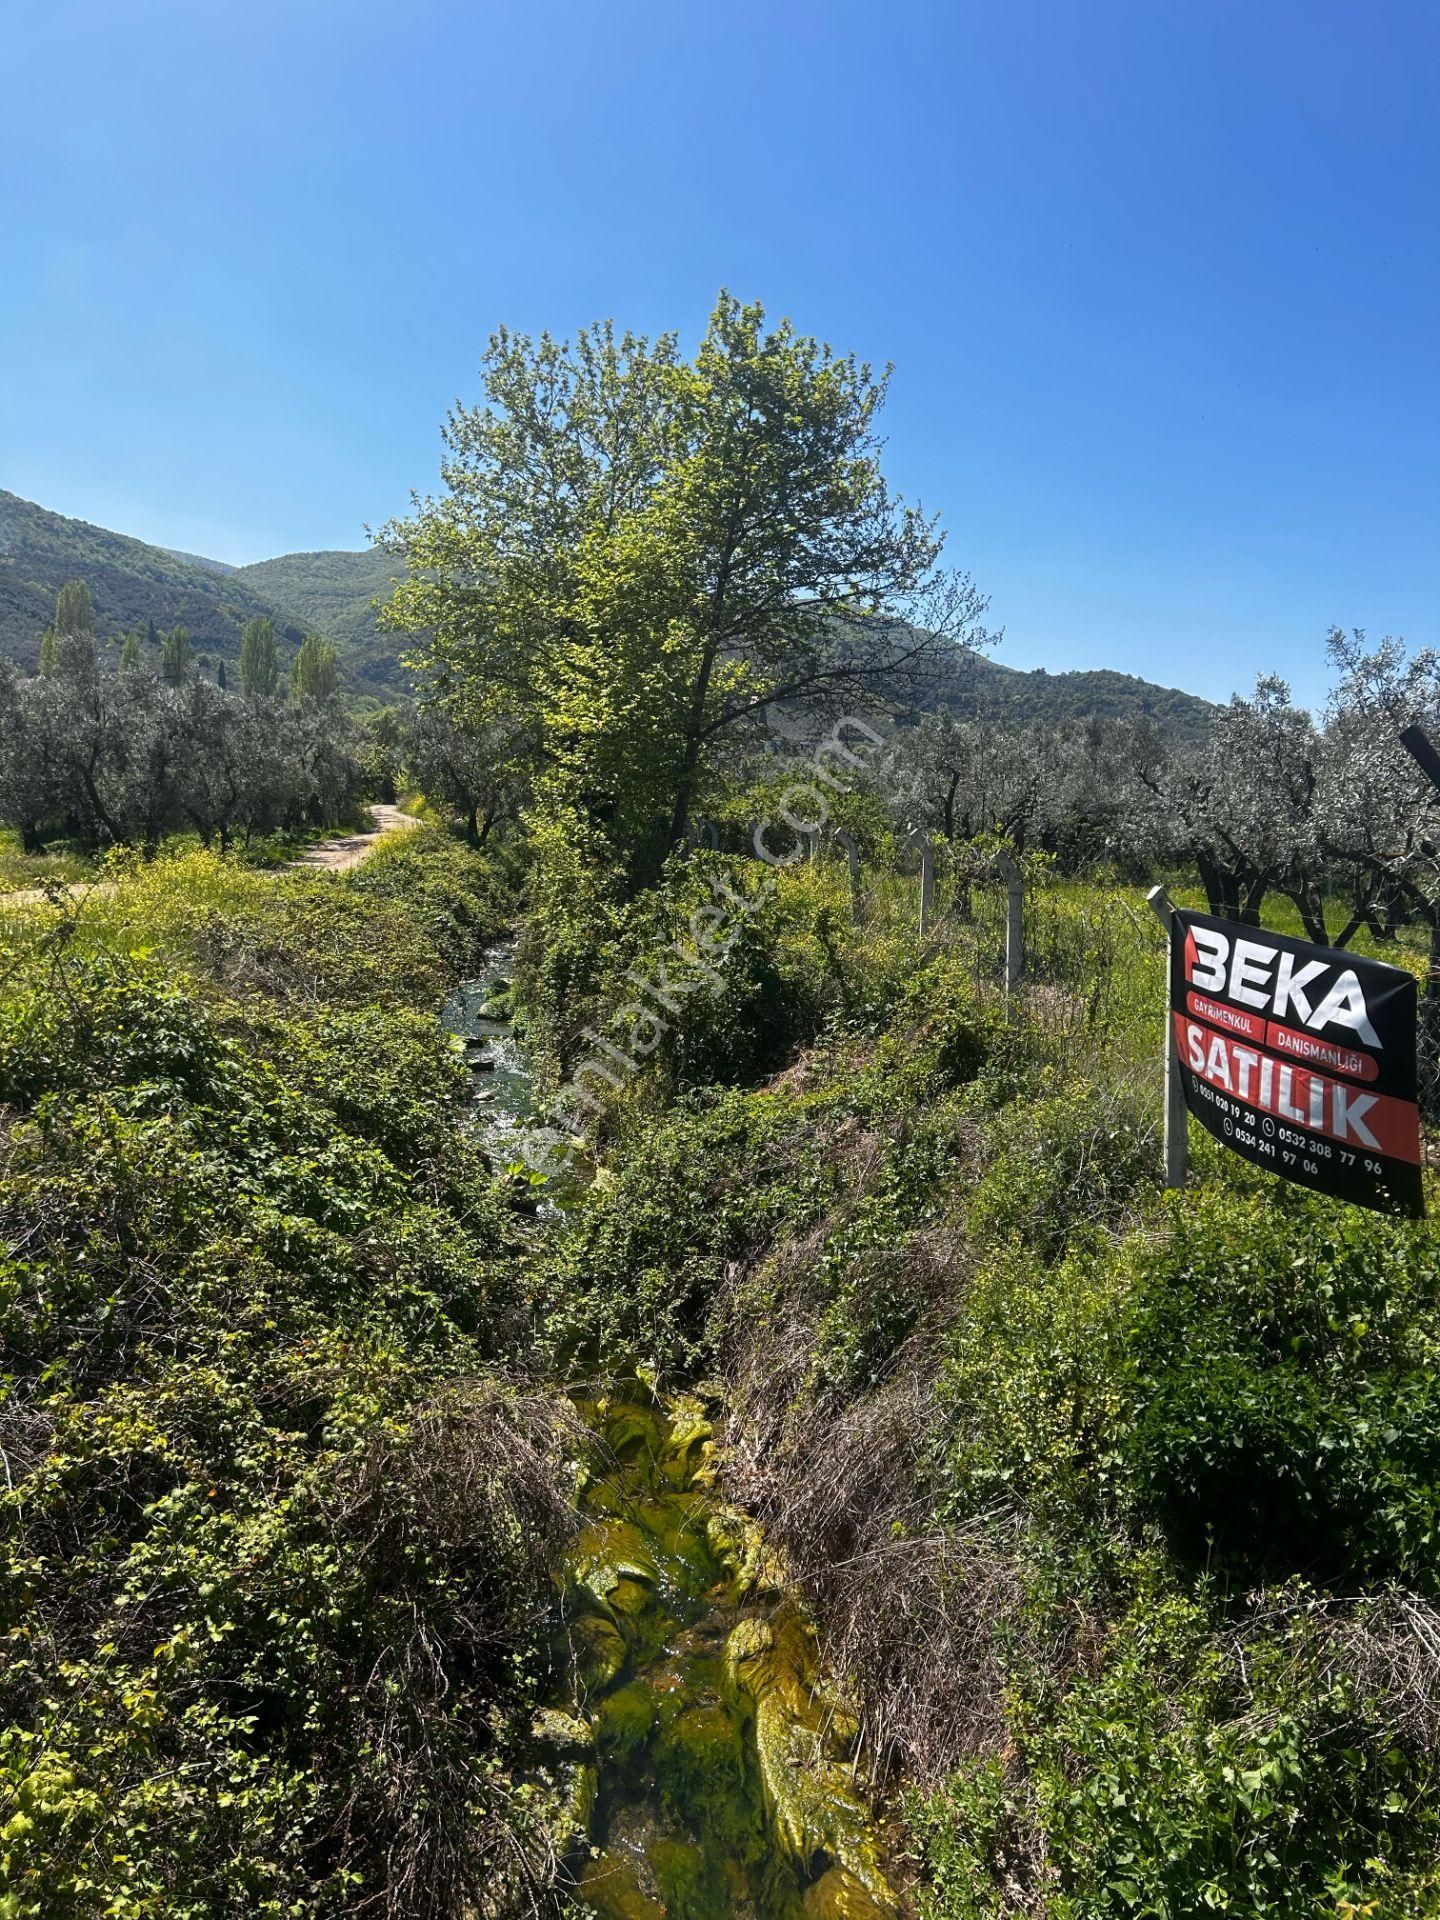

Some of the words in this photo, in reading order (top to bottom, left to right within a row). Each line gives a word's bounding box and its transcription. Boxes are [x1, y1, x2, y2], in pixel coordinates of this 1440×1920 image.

[1185, 925, 1384, 1050] BEKA
[1187, 1024, 1383, 1150] SATILIK
[1215, 1095, 1229, 1112] 020
[1230, 1104, 1240, 1118] 19
[1243, 1111, 1256, 1126] 20
[1279, 1127, 1306, 1150] 0532
[1309, 1140, 1332, 1159] 308
[1339, 1151, 1356, 1167] 77
[1363, 1159, 1383, 1176] 96
[1235, 1128, 1257, 1148] 0534
[1258, 1139, 1276, 1157] 241
[1282, 1150, 1296, 1166] 97
[1303, 1159, 1319, 1175] 06
